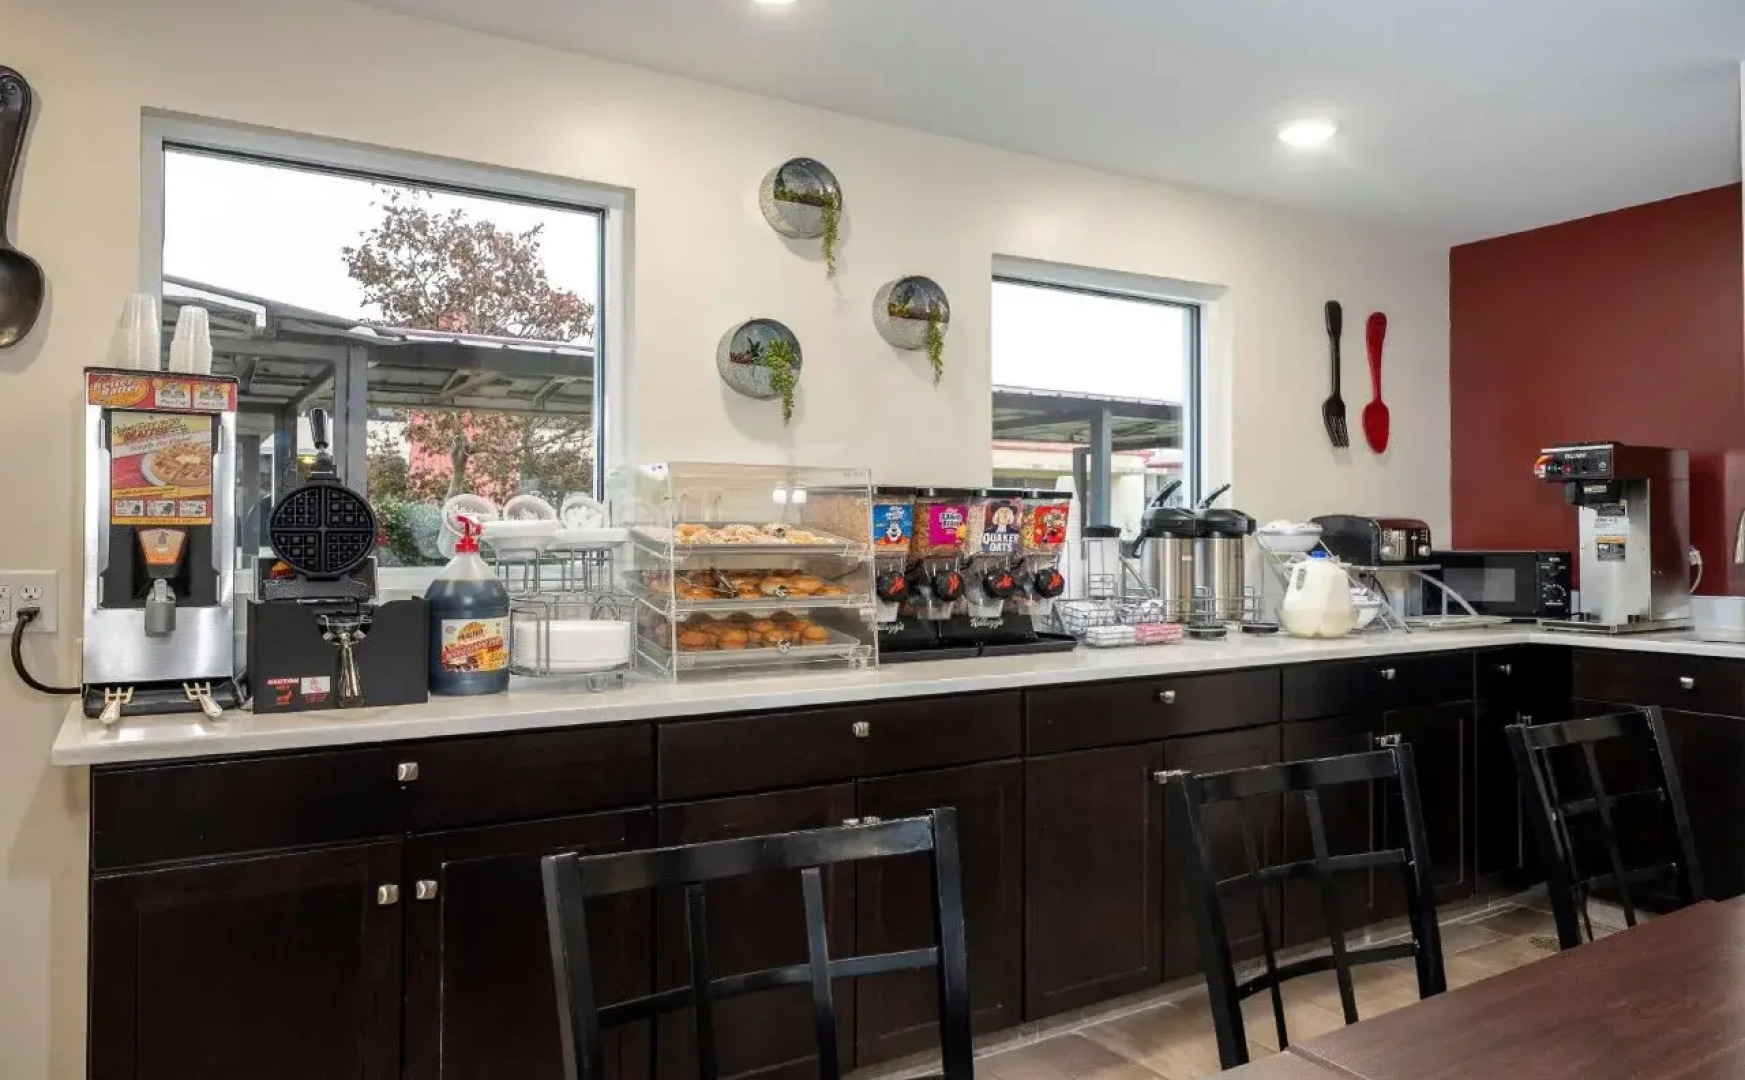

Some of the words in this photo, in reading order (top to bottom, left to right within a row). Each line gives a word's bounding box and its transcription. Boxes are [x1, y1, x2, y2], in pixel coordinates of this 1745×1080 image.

[983, 532, 1020, 545] QUAKER
[989, 542, 1013, 552] OATS
[267, 677, 299, 686] CAUTION
